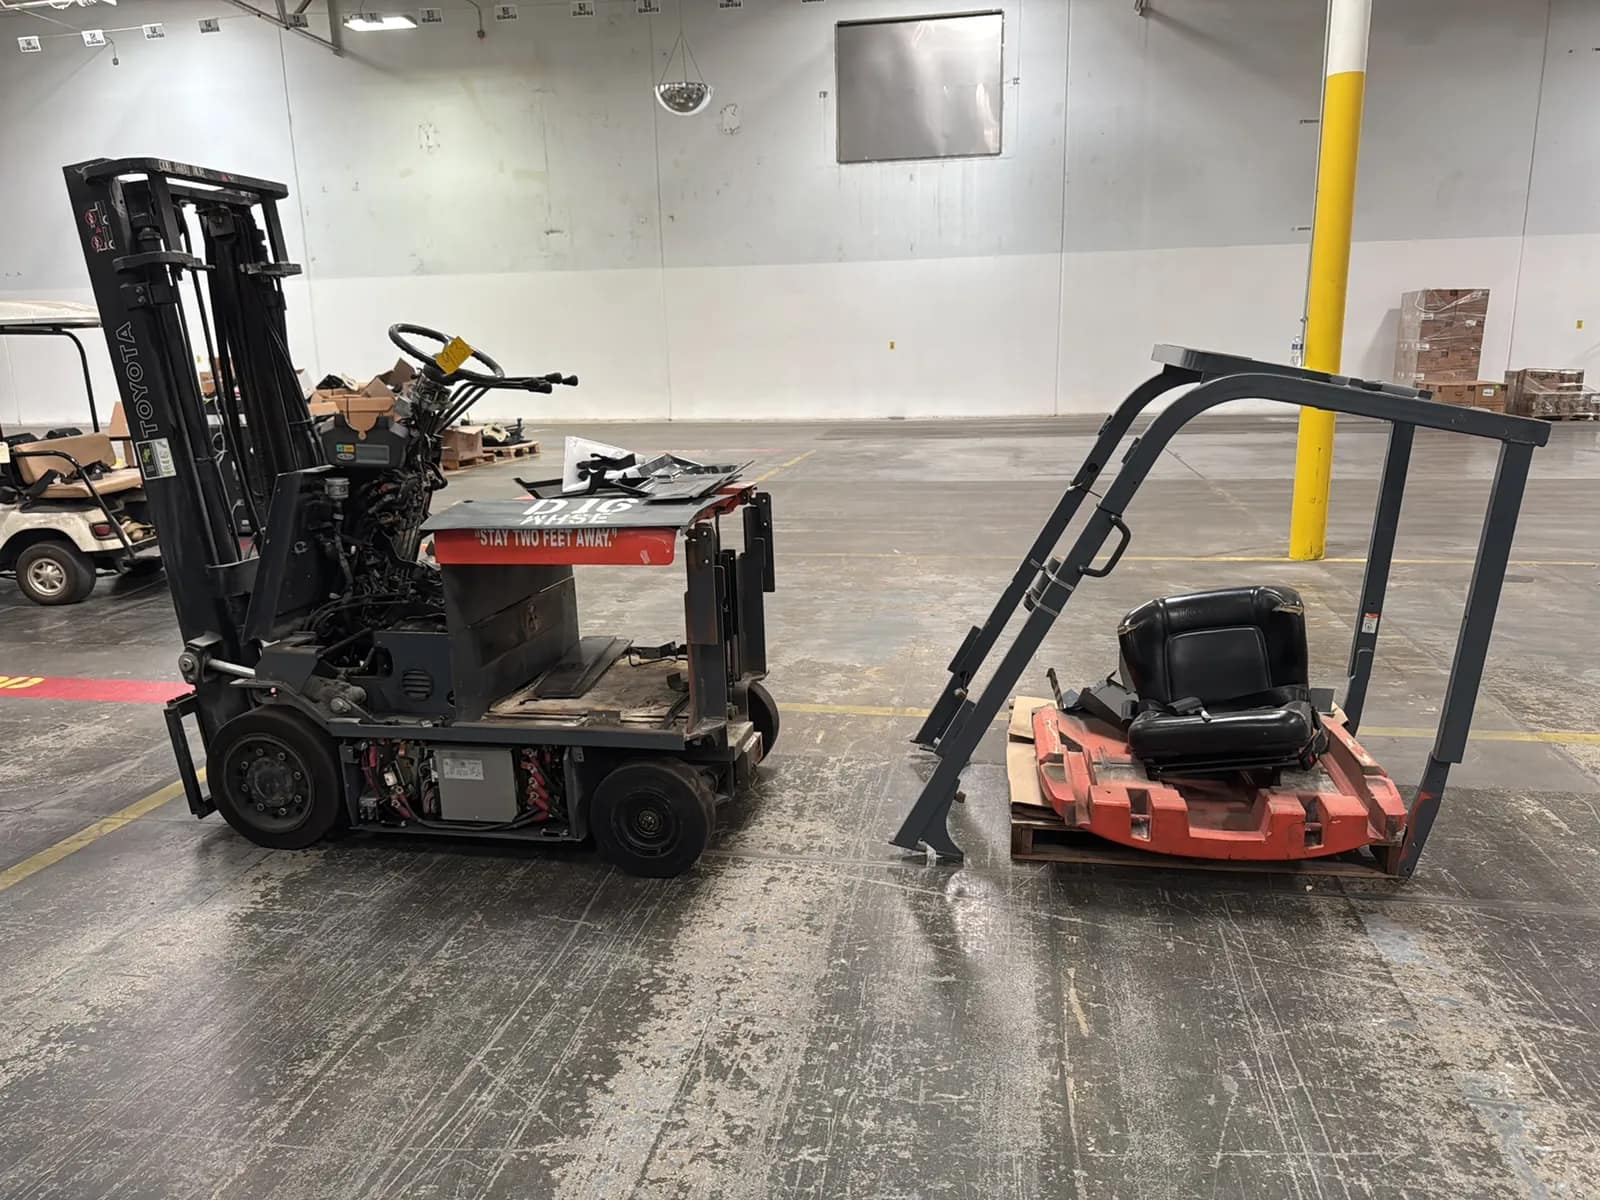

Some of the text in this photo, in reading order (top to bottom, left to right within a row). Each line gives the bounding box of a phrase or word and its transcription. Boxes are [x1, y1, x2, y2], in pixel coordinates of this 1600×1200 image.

[115, 321, 159, 439] TOYOTA
[474, 528, 510, 546] "STAY
[513, 528, 541, 547] TWO
[543, 528, 573, 547] FEET
